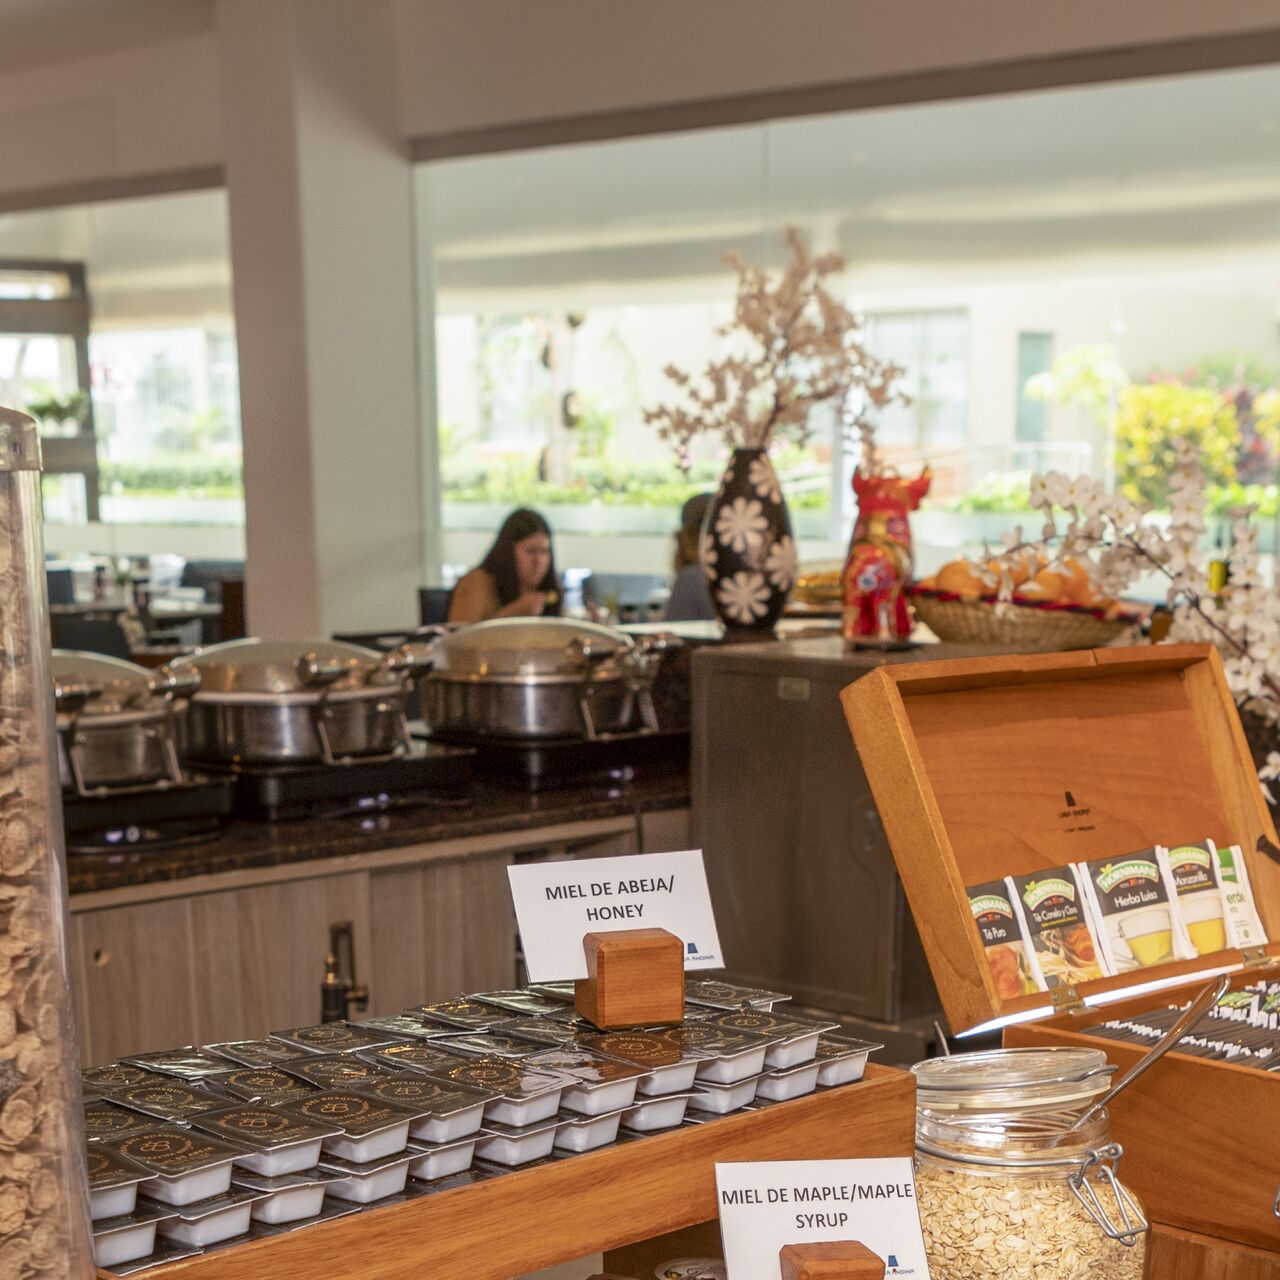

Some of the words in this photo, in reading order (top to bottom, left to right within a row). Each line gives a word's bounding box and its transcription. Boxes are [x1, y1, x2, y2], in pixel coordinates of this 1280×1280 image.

[1102, 864, 1157, 887] HORNIMANS
[545, 884, 587, 901] MIEL
[591, 882, 613, 897] DE
[617, 875, 675, 894] ABEJA/
[1114, 893, 1141, 908] Hierba
[586, 904, 644, 921] HONEY
[993, 927, 1007, 938] Puro
[722, 1189, 763, 1205] MIEL
[768, 1188, 788, 1203] DE
[794, 1183, 913, 1203] MAPLE/MAPLE
[796, 1213, 848, 1229] SYRUP
